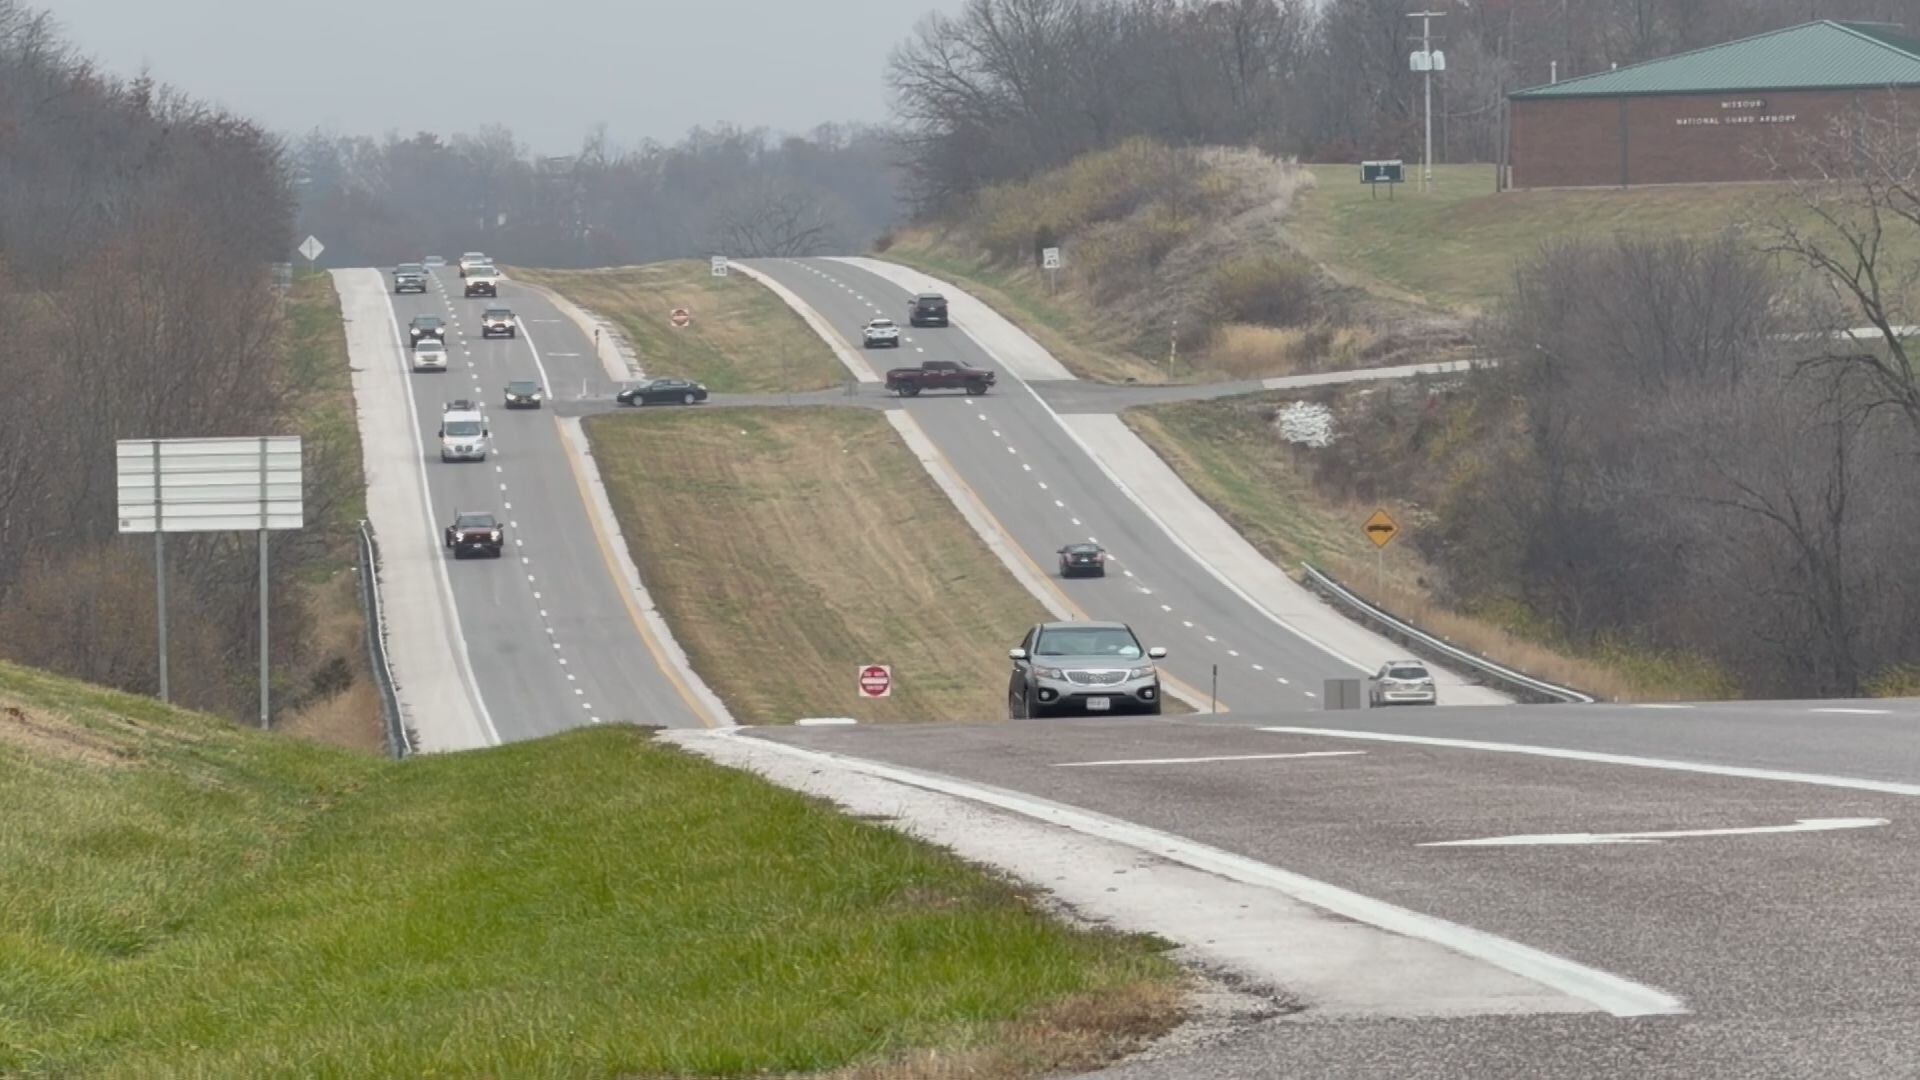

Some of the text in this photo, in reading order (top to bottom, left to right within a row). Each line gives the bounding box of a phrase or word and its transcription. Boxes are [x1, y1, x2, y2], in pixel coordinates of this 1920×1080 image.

[1676, 115, 1795, 125] NATIONAL GUARD ARMORY
